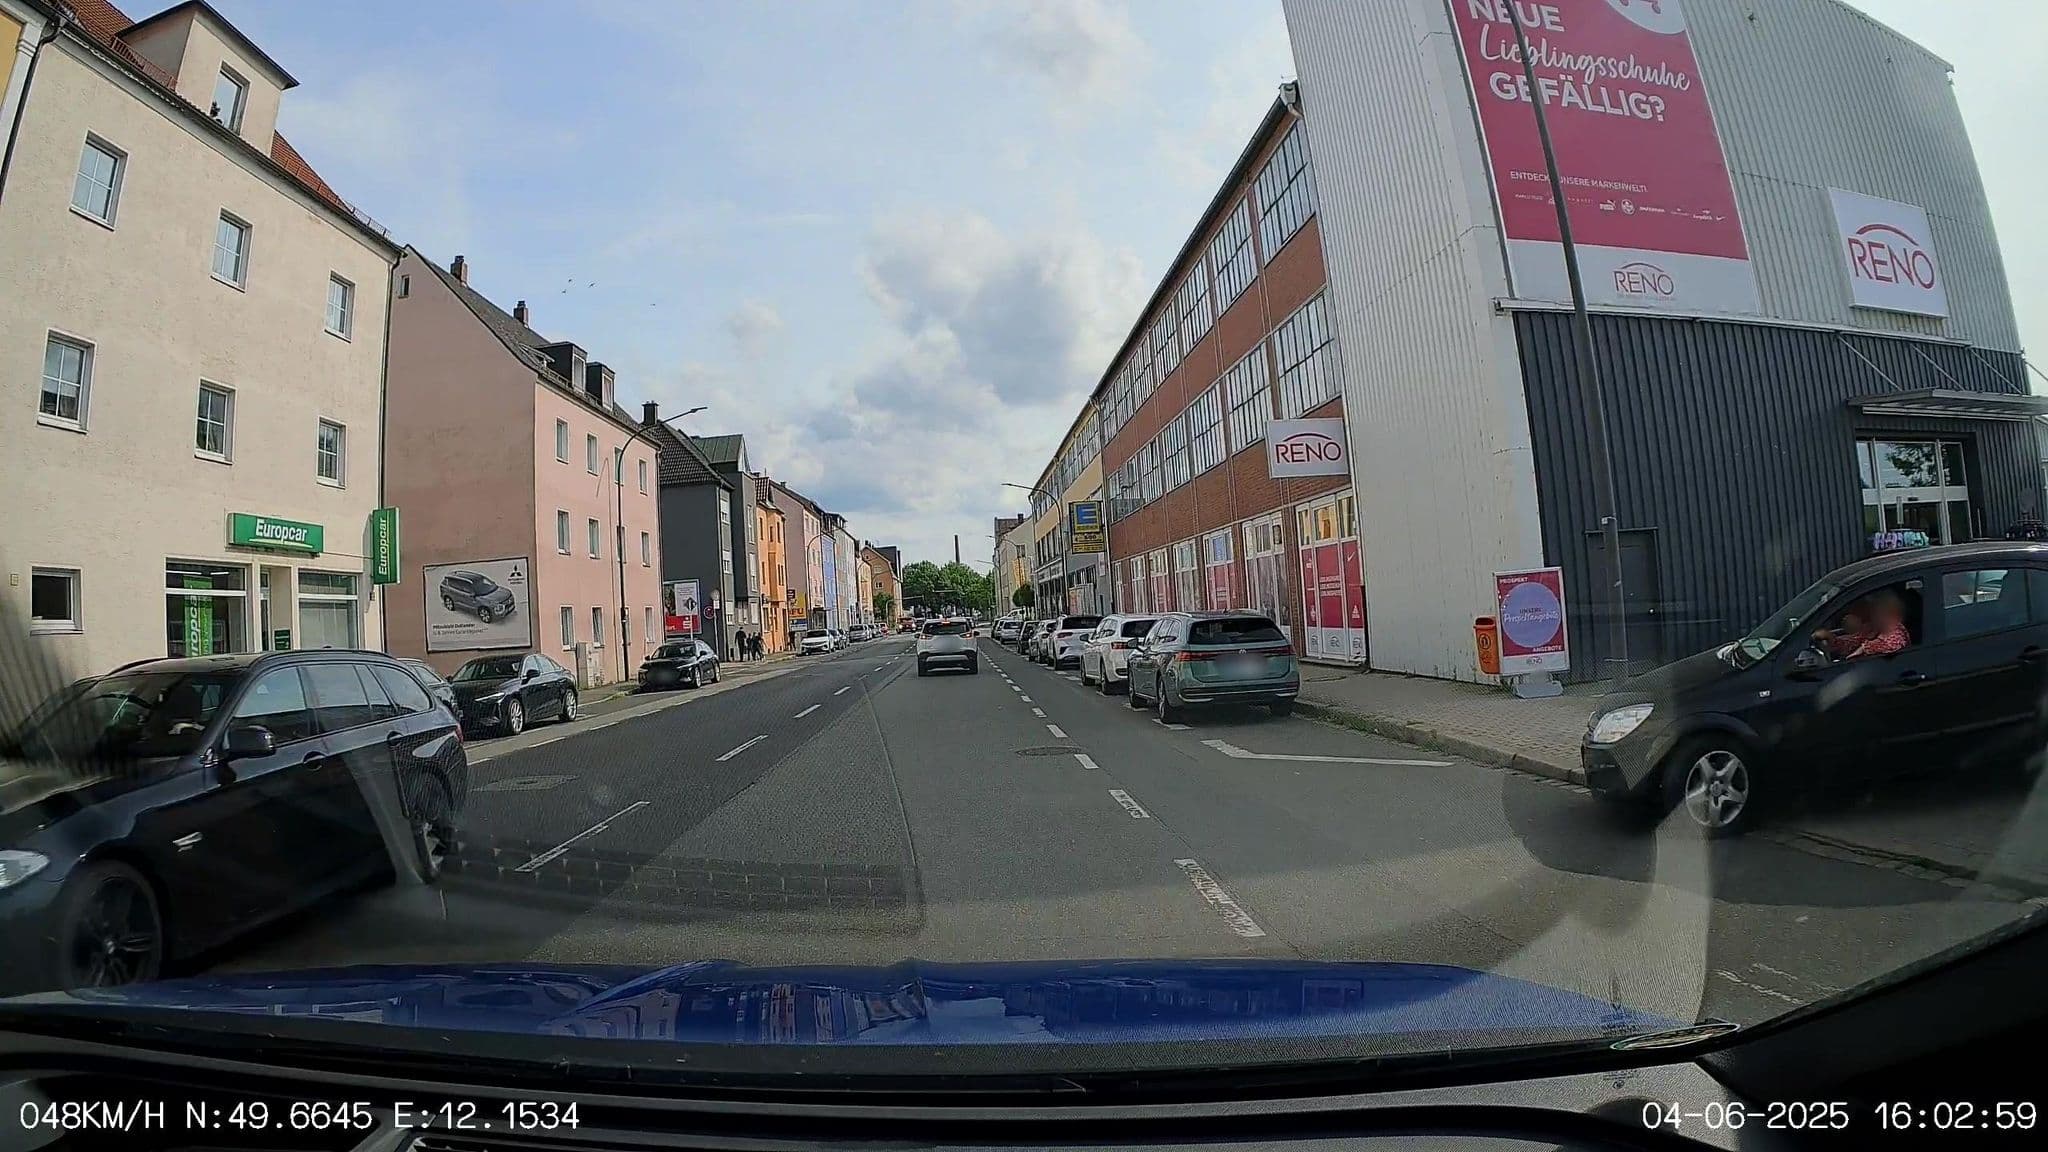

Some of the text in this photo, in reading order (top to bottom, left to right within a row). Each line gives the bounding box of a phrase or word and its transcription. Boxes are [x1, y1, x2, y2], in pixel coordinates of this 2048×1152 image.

[1467, 0, 1565, 32] NEUE
[1480, 23, 1690, 91] Lieblingsschuhe
[1489, 72, 1665, 122] GEFÄLLIG?
[1510, 170, 1551, 183] ENTDECK
[1847, 237, 1935, 290] RENO
[1614, 270, 1674, 296] RENO
[1275, 441, 1342, 464] RENO
[255, 518, 308, 543] Europcar
[378, 517, 389, 576] Europcar
[1532, 645, 1562, 653] ANGEBOTE
